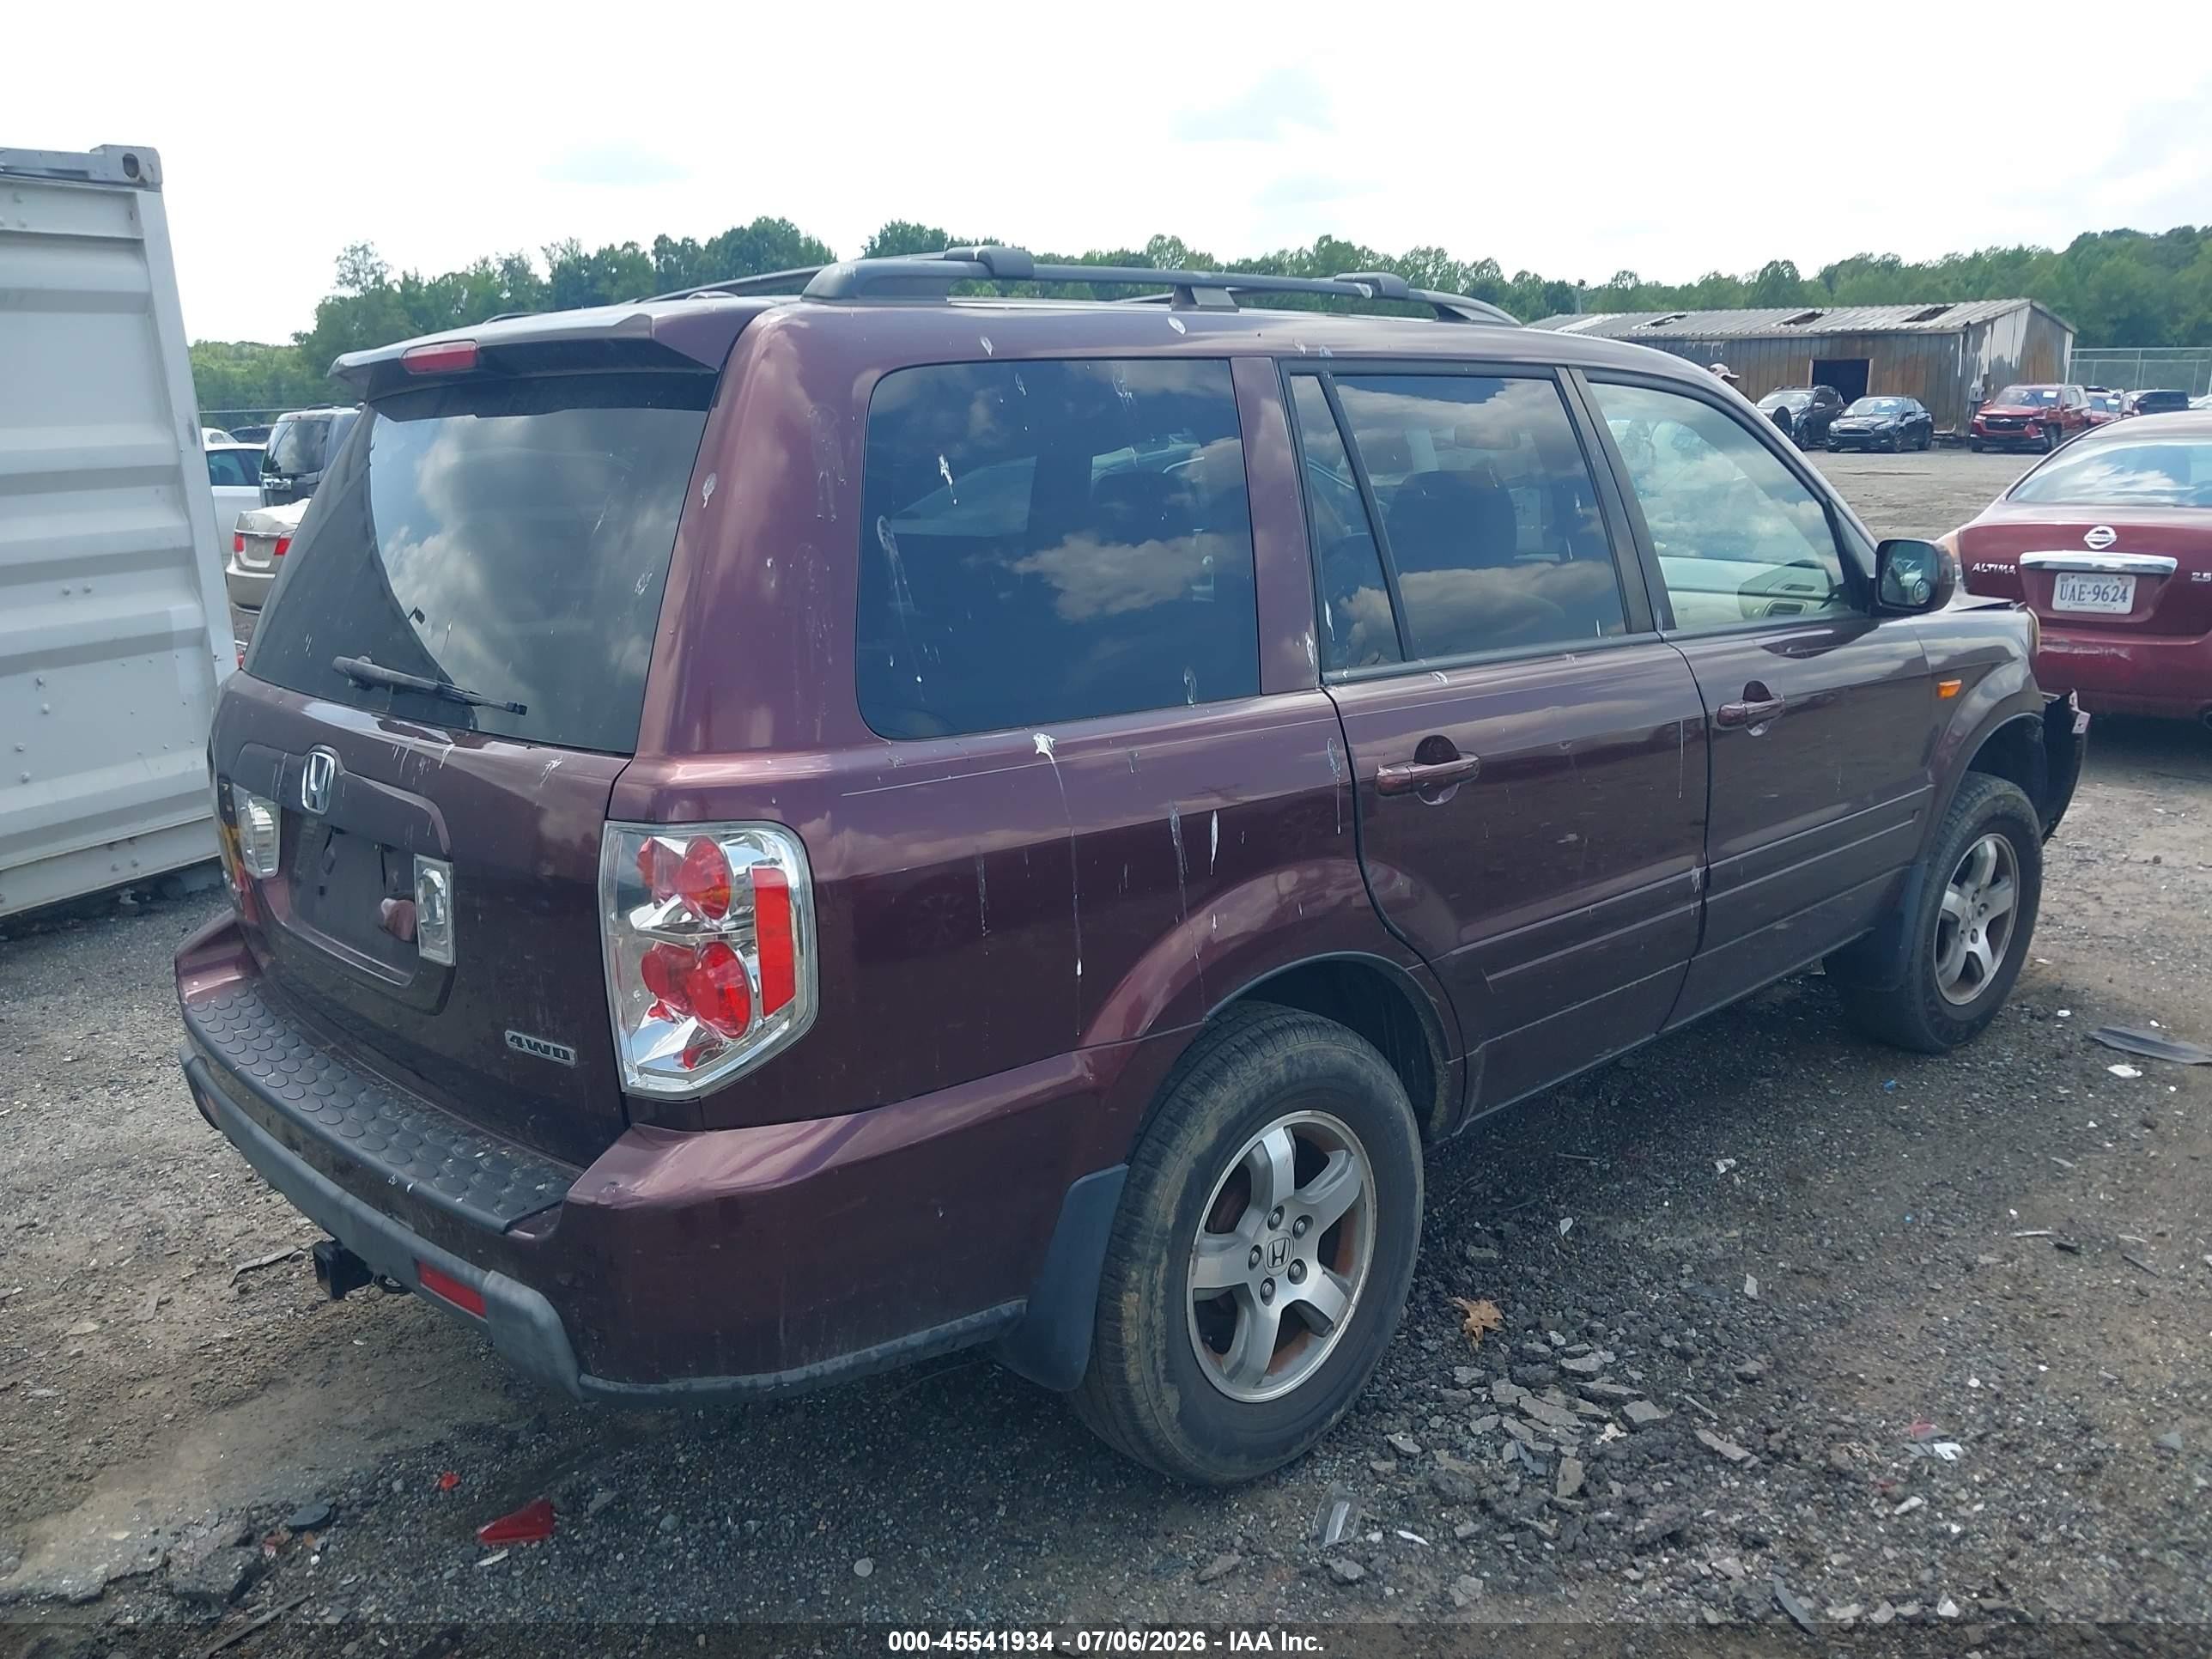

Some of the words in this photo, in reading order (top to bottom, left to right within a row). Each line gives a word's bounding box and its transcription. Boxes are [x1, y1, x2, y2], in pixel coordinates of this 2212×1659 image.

[1972, 562, 2016, 575] ALTIMA
[2060, 583, 2129, 603] UAE-9624
[508, 1034, 572, 1062] 4WD
